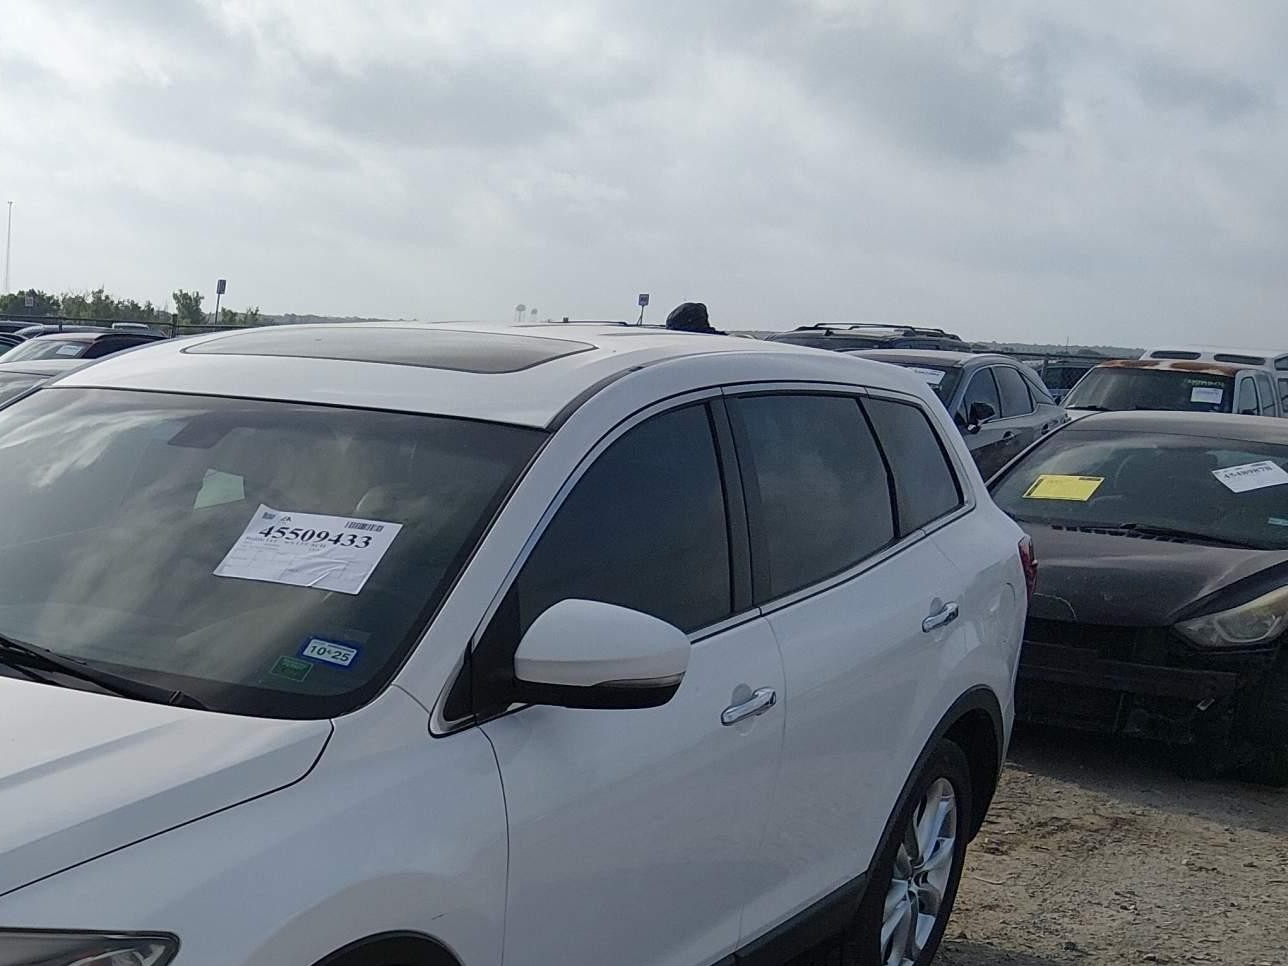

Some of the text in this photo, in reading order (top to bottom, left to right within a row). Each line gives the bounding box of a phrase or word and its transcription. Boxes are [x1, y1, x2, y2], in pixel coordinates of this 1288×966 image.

[259, 525, 373, 549] 45509433
[310, 645, 327, 656] 10
[331, 650, 350, 662] 25
